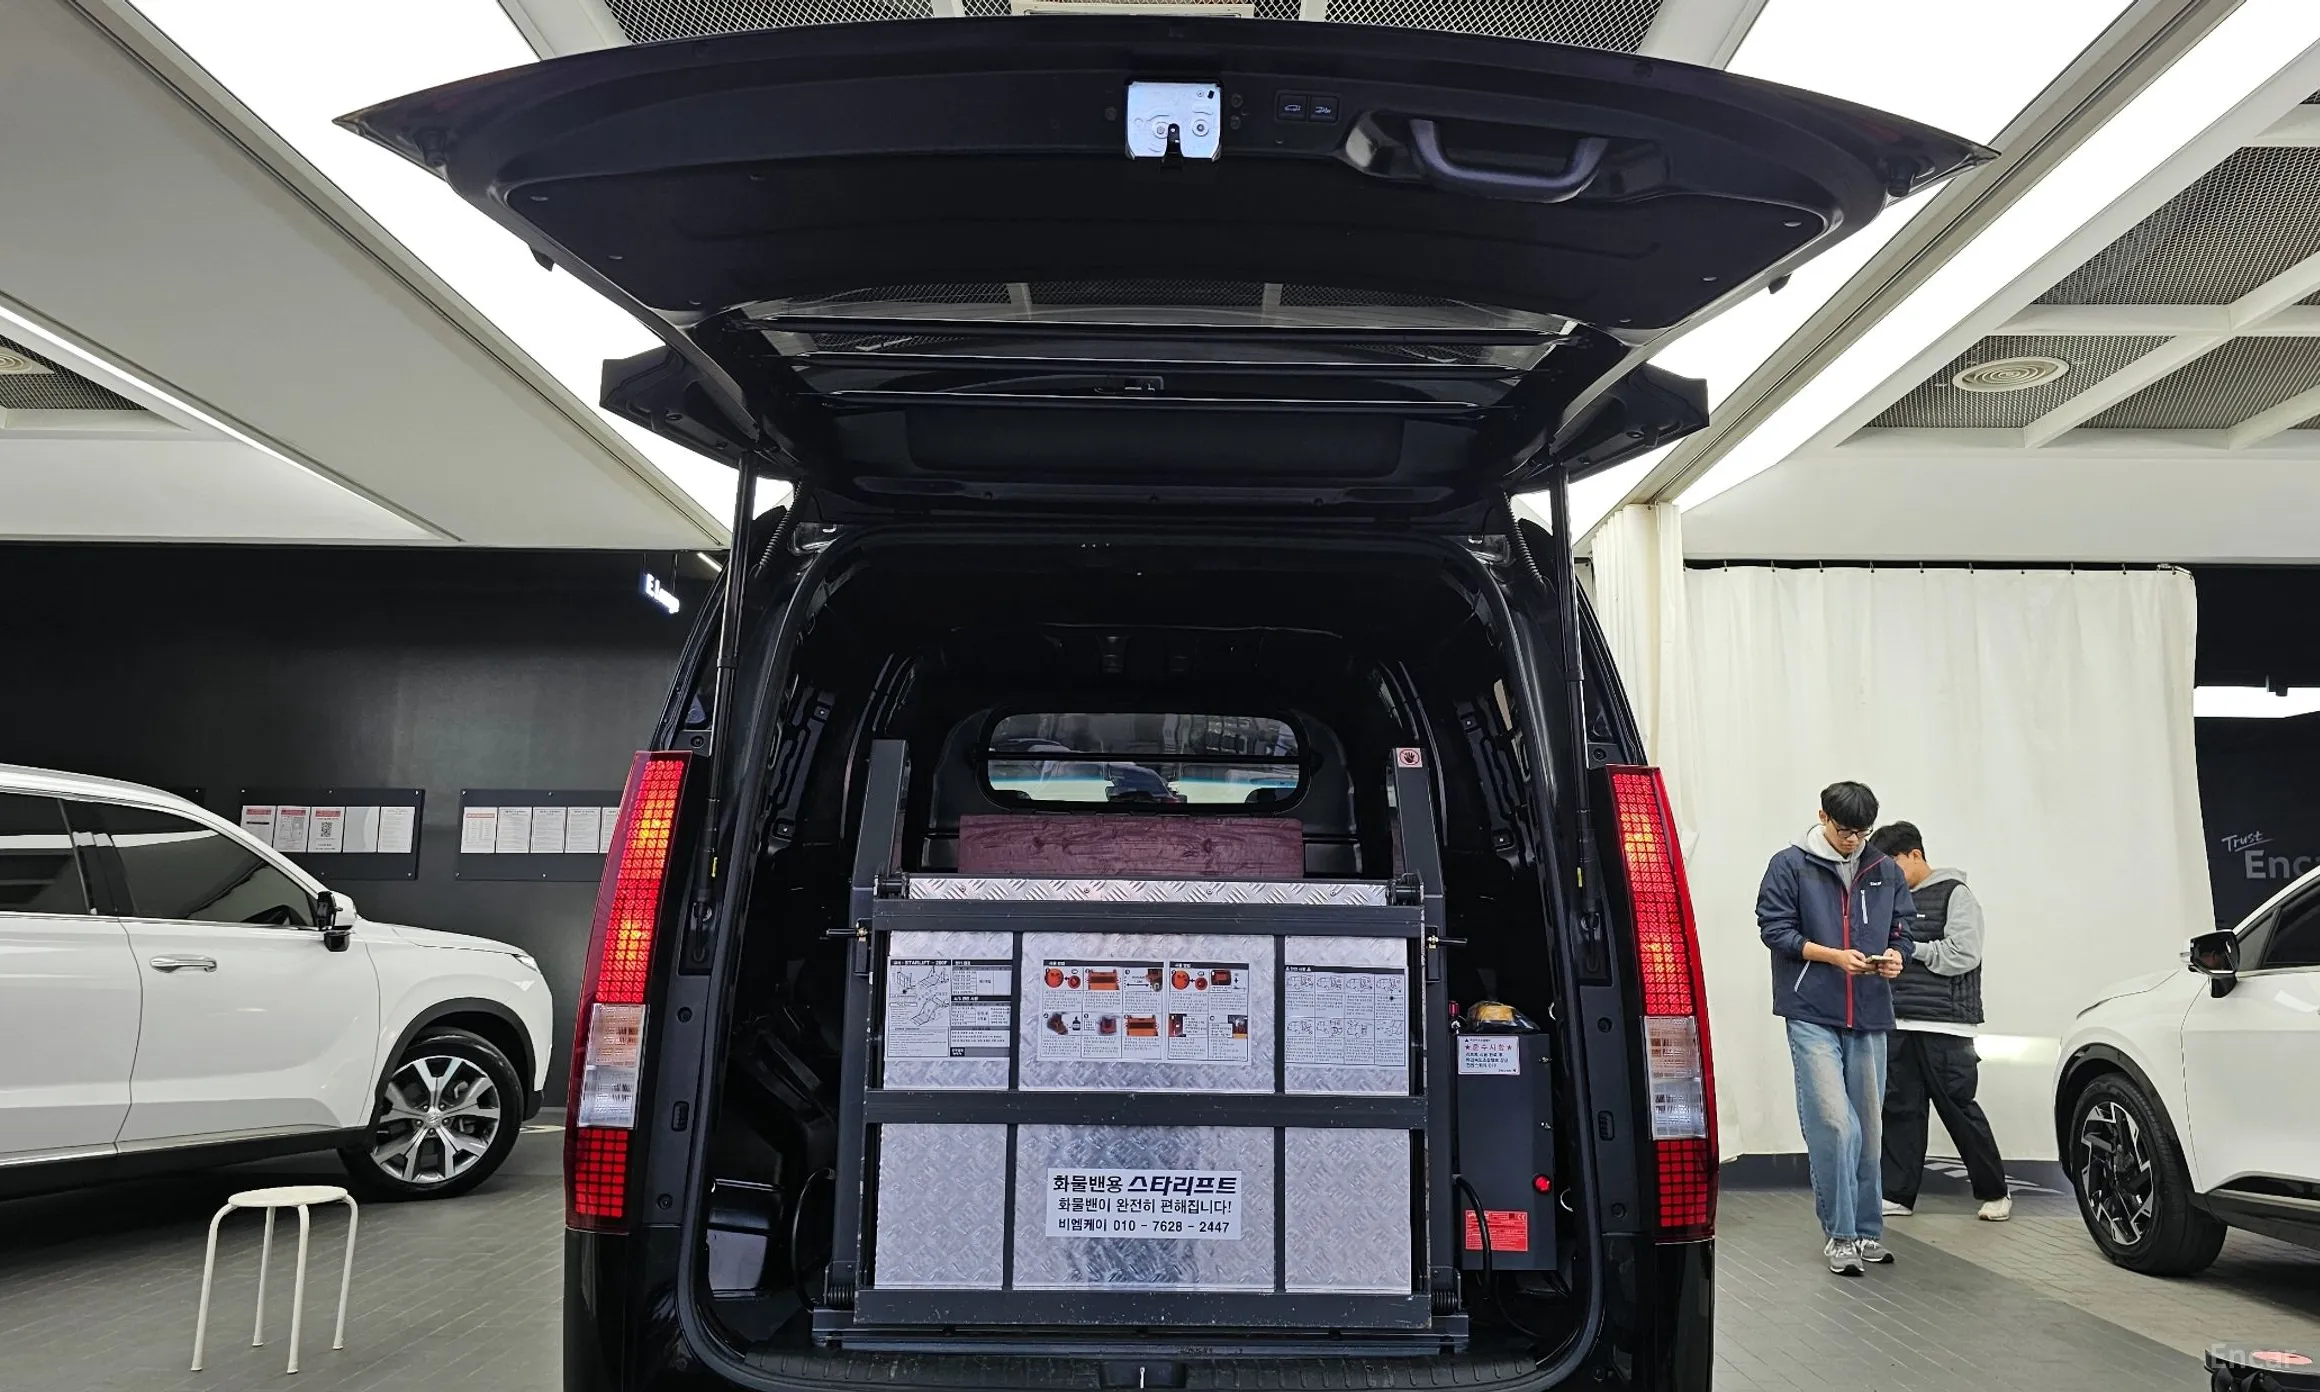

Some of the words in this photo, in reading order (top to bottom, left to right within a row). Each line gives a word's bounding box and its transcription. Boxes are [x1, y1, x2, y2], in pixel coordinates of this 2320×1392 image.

[2221, 831, 2264, 853] Trust
[2245, 850, 2320, 880] Enc
[1053, 1175, 1123, 1193] 화물밴용
[1127, 1176, 1237, 1196] 스타리프트
[1058, 1197, 1111, 1213] 화물밴이
[1116, 1198, 1155, 1213] 완전히
[1160, 1199, 1232, 1215] 편해집니다!
[1058, 1219, 1107, 1232] 비엠케이
[1113, 1220, 1136, 1231] 010
[1152, 1221, 1183, 1232] 7628
[1199, 1222, 1230, 1233] 2447
